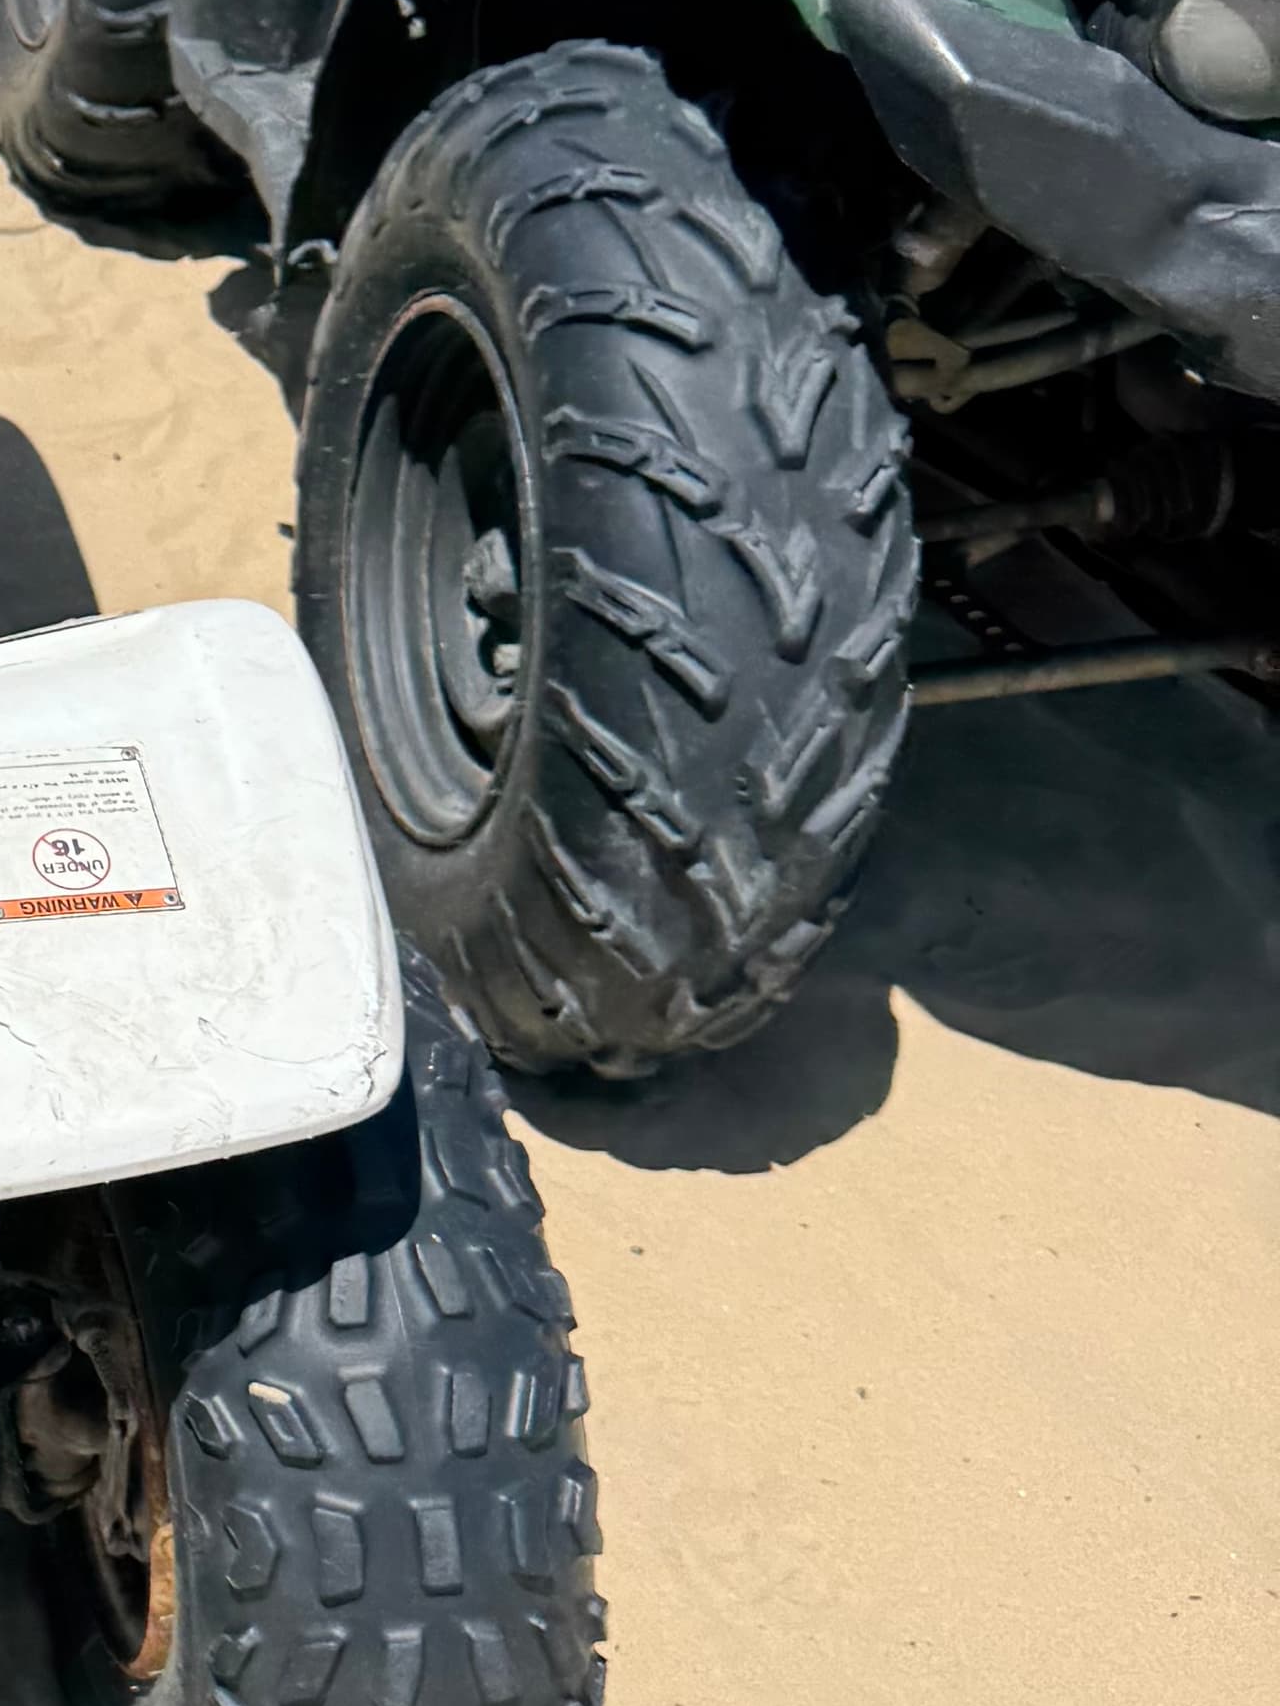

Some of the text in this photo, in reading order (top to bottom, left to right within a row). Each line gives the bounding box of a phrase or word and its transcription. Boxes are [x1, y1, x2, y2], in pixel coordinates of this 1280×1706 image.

[52, 838, 85, 856] 16
[42, 859, 104, 874] UNDER
[19, 895, 120, 915] WARNING
